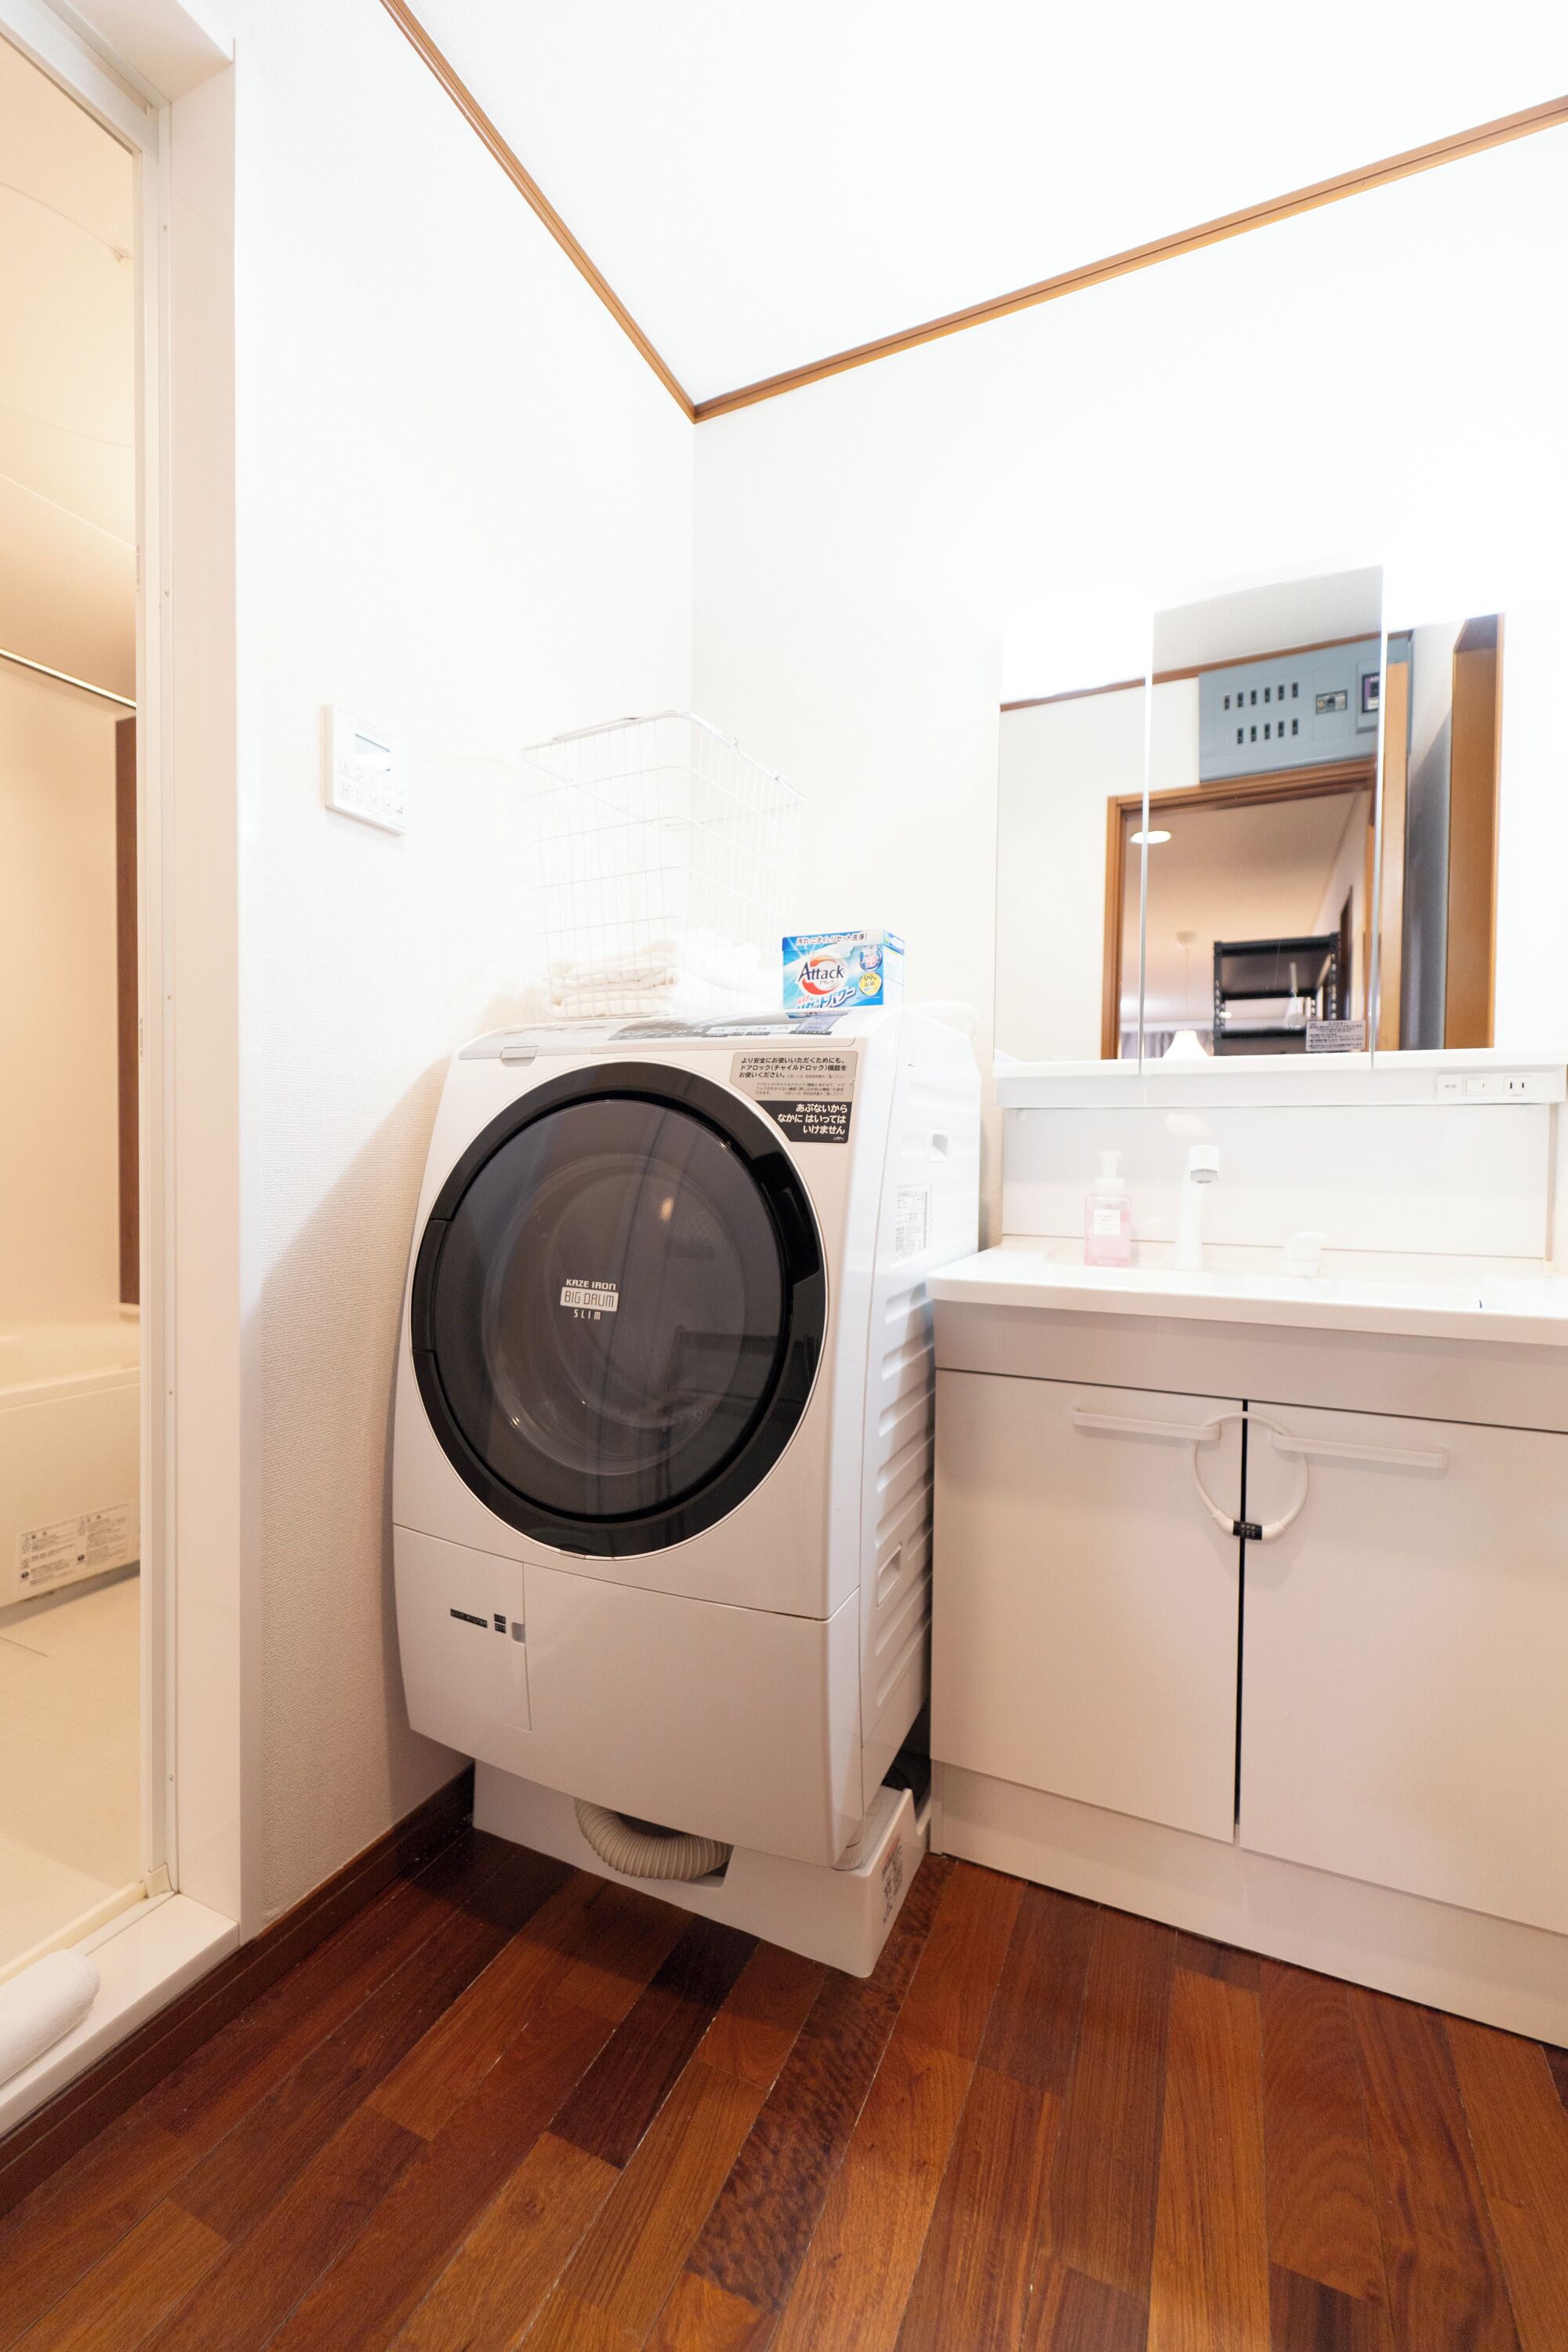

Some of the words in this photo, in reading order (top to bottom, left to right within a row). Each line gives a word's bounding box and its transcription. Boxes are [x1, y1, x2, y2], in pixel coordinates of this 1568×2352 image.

[797, 962, 844, 982] Attack
[741, 1056, 845, 1065] より安全にお使いいただくためにも、
[795, 1103, 848, 1113] あぶないから
[777, 1113, 804, 1123] なかに
[805, 1114, 847, 1124] はいっては
[803, 1125, 846, 1135] いけません
[565, 1279, 590, 1288] KAZE
[591, 1281, 616, 1291] IRON
[564, 1290, 581, 1304] BIG
[583, 1292, 615, 1308] DRUM
[573, 1308, 601, 1320] SLIM
